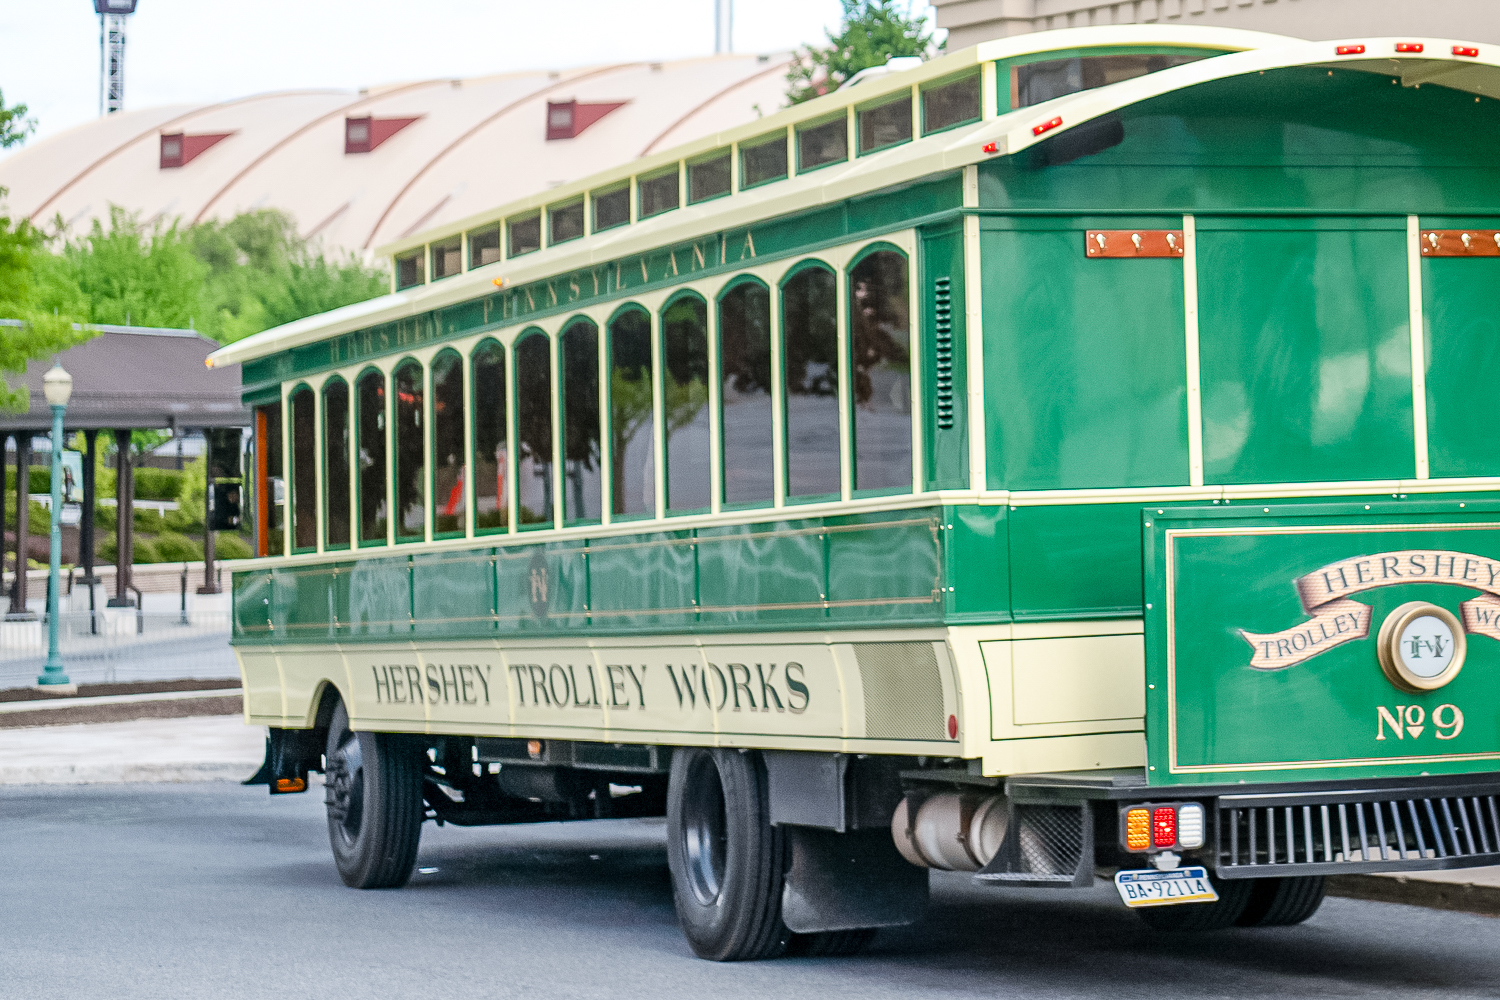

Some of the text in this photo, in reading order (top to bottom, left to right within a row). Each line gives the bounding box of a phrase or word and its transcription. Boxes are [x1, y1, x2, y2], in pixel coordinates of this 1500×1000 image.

[1259, 611, 1364, 660] TROLLEY
[371, 660, 811, 715] HERSHEY TROLLEY WORKS
[1431, 703, 1465, 741] 9
